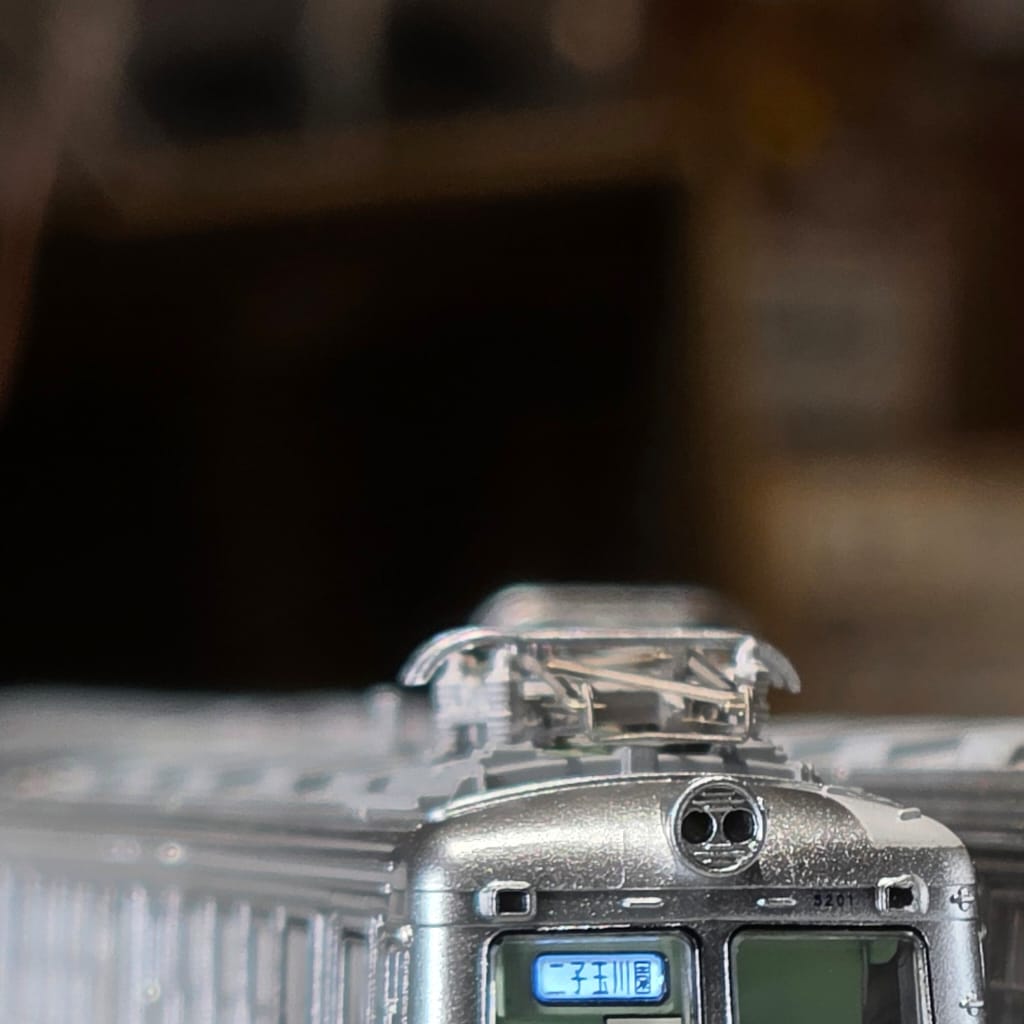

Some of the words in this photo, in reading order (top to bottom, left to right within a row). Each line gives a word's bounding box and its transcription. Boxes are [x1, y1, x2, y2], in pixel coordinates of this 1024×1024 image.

[544, 960, 651, 995] 二子玉川園
